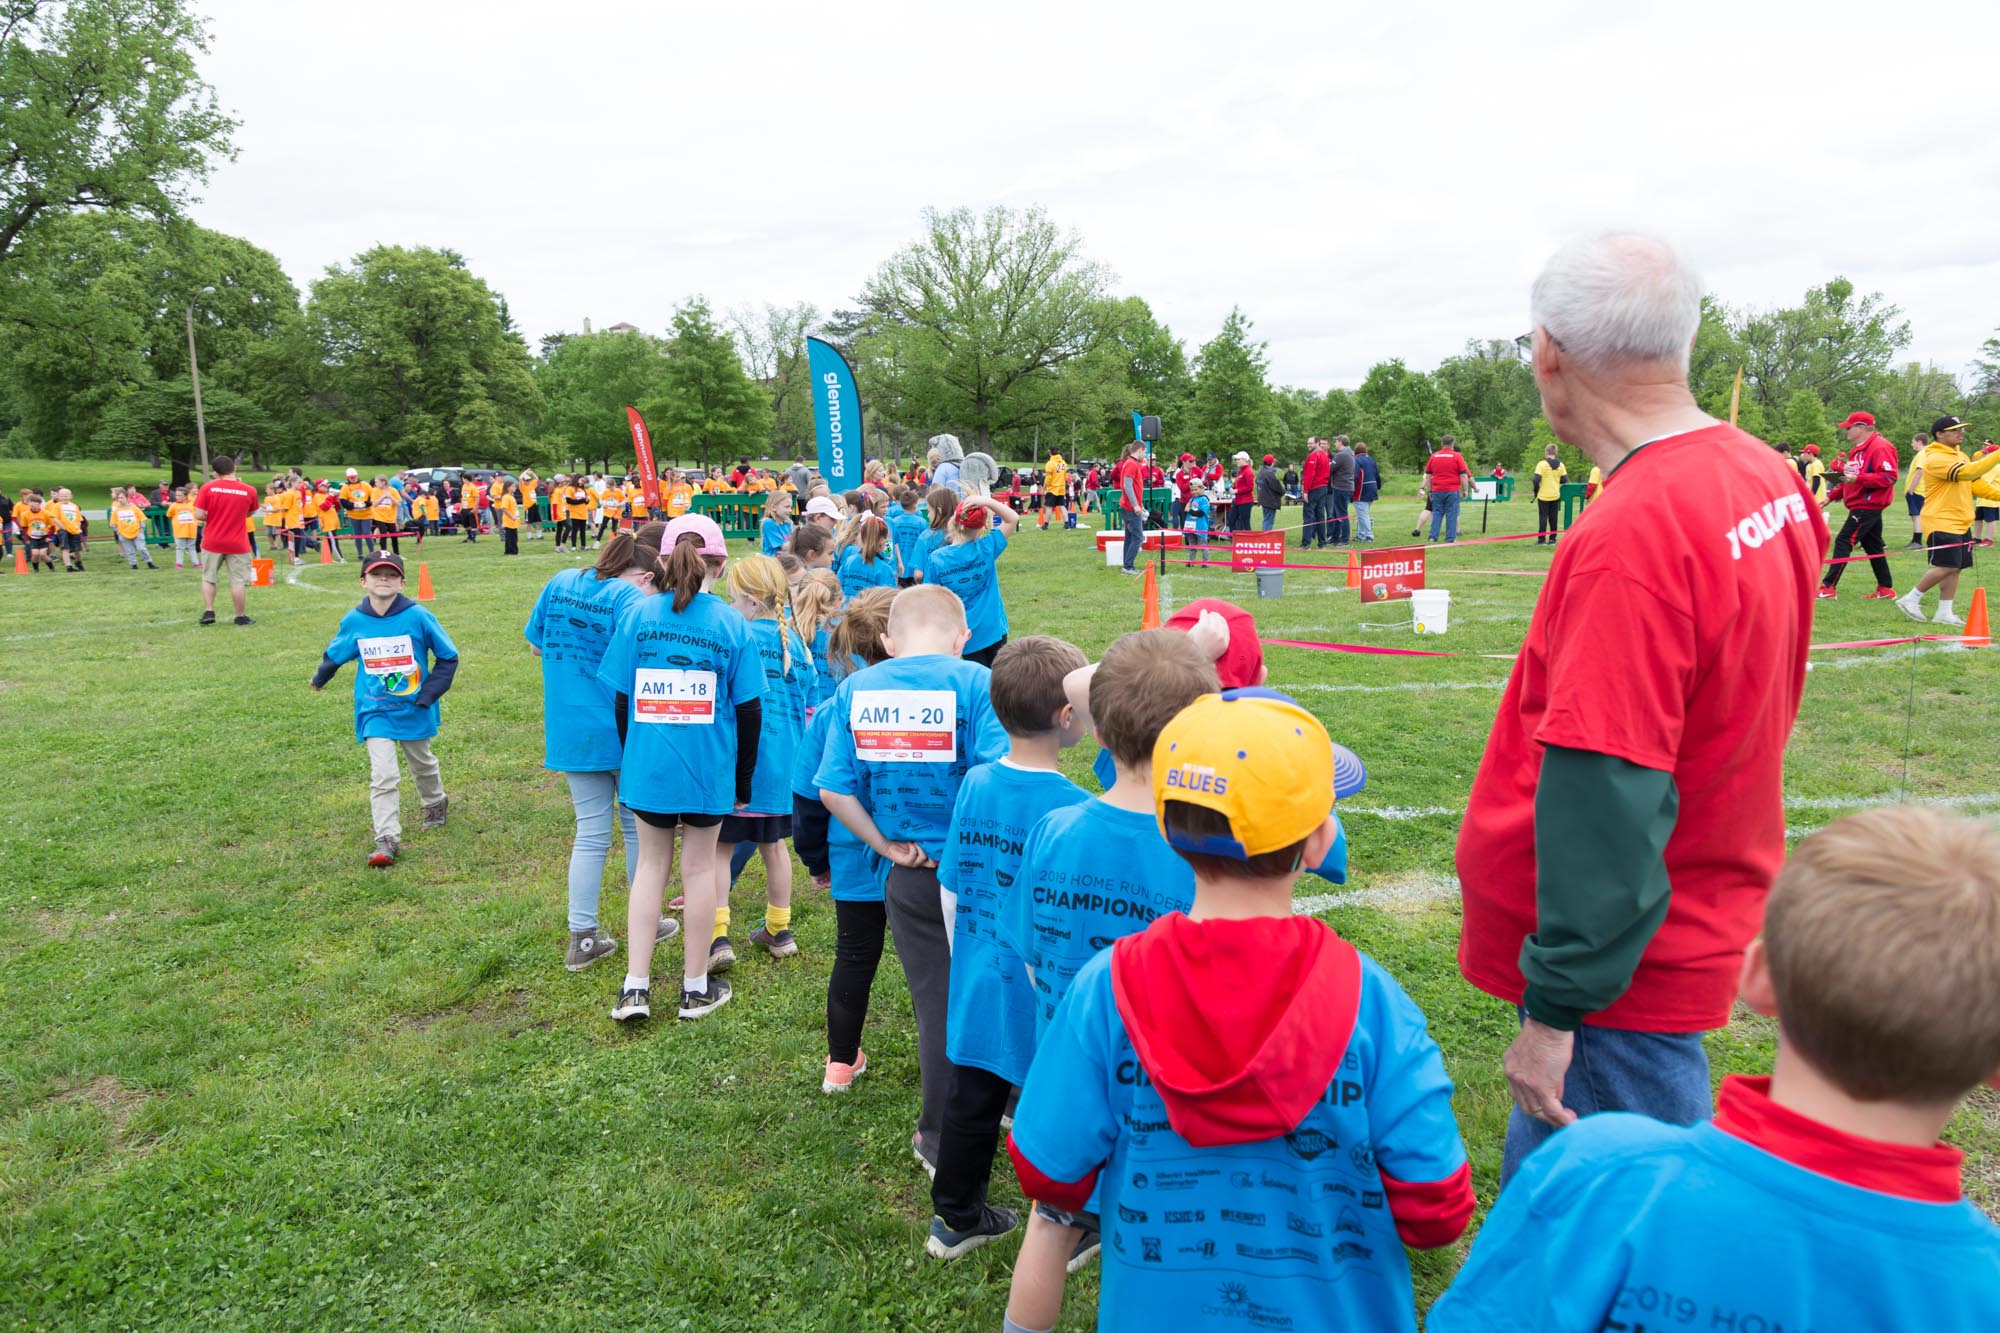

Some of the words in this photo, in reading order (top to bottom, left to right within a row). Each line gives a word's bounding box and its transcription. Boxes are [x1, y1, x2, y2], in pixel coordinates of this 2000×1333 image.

[823, 371, 845, 478] glennon.org
[379, 550, 391, 559] P
[1362, 559, 1424, 580] DOUBLE
[393, 644, 406, 654] 27
[636, 630, 731, 660] CHAMPIONSHIPS
[641, 682, 673, 695] AM1
[690, 683, 707, 696] 18
[858, 707, 900, 723] AM1
[921, 708, 944, 725] 20
[1166, 767, 1228, 796] BLUES
[959, 817, 977, 828] 019
[1039, 869, 1066, 884] 2019
[1070, 873, 1115, 891] HOME
[1119, 881, 1150, 899] RUN
[1153, 892, 1192, 915] DERB
[1033, 886, 1160, 924] CHAMPIONS
